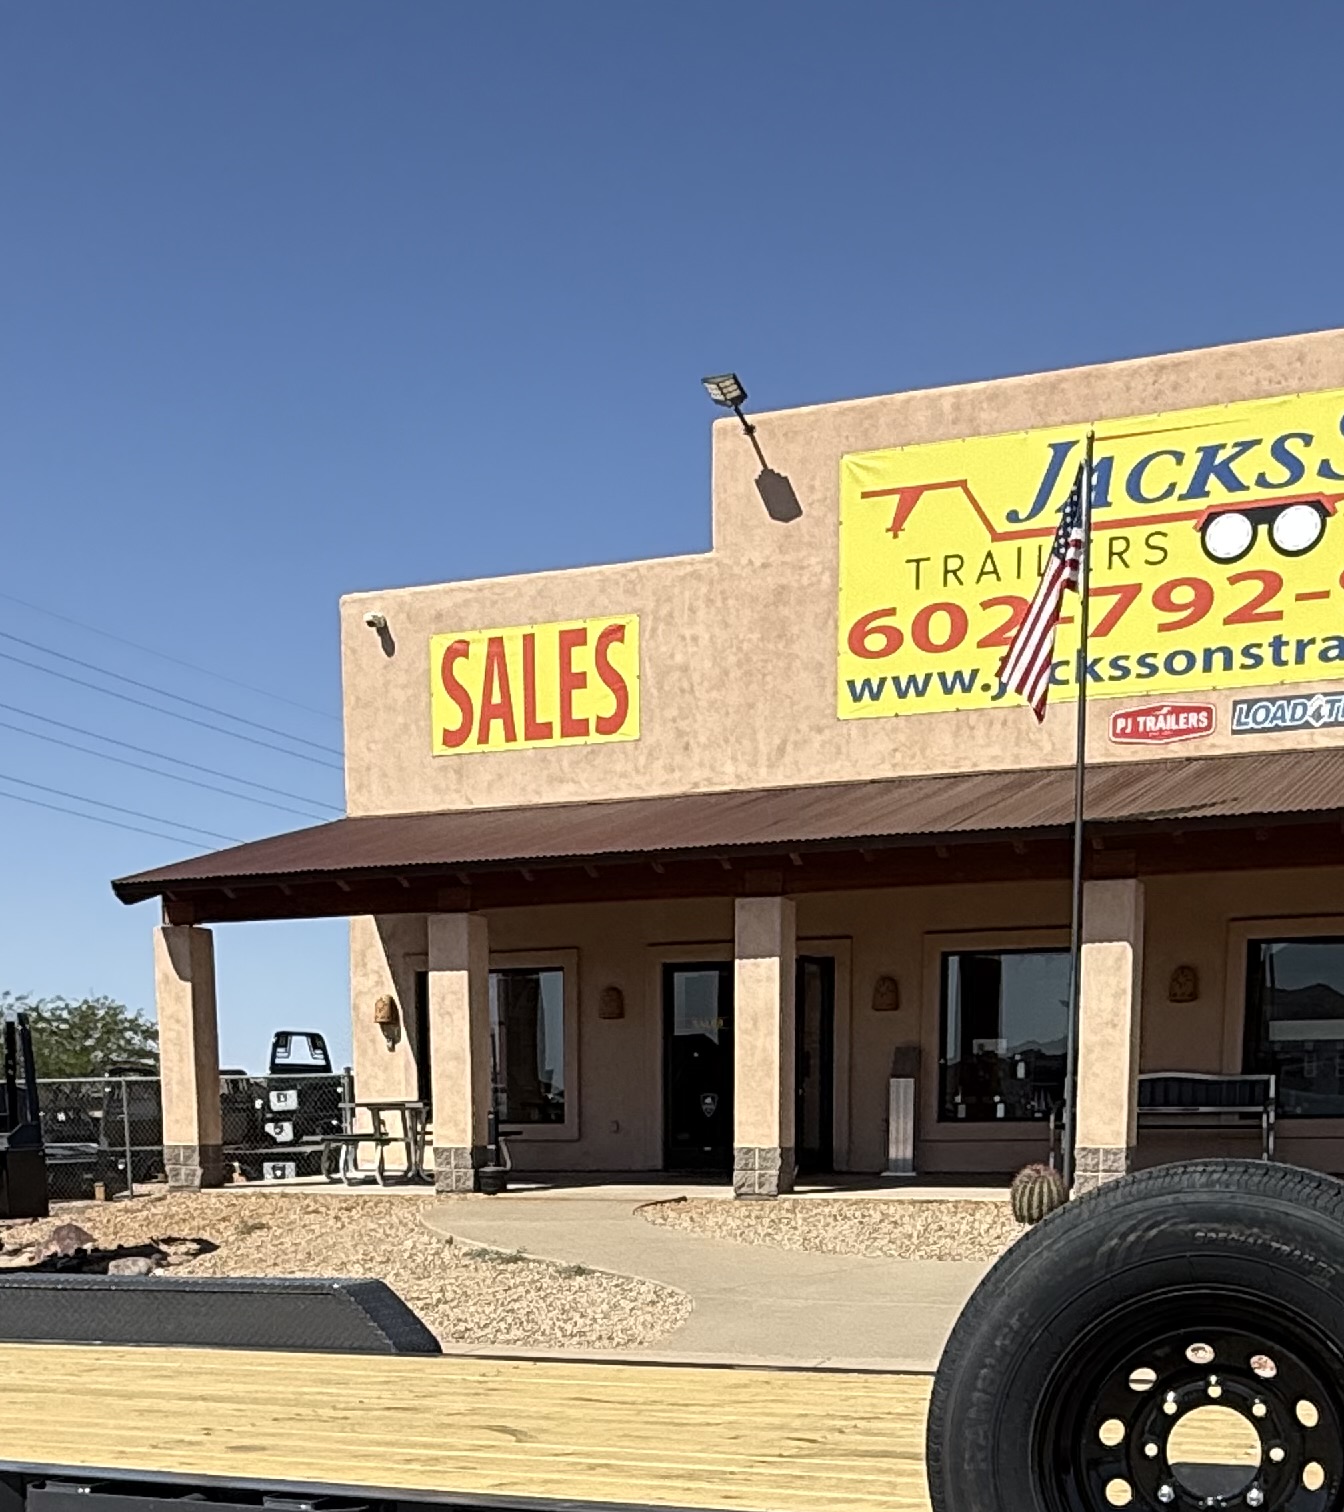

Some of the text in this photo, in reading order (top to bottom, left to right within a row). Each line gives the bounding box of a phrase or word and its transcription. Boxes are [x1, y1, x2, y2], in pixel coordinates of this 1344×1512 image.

[906, 530, 1169, 591] TRAILRS
[440, 624, 630, 749] SALES
[1116, 711, 1208, 734] PJ TRAILERS
[1233, 700, 1309, 730] LOAD
